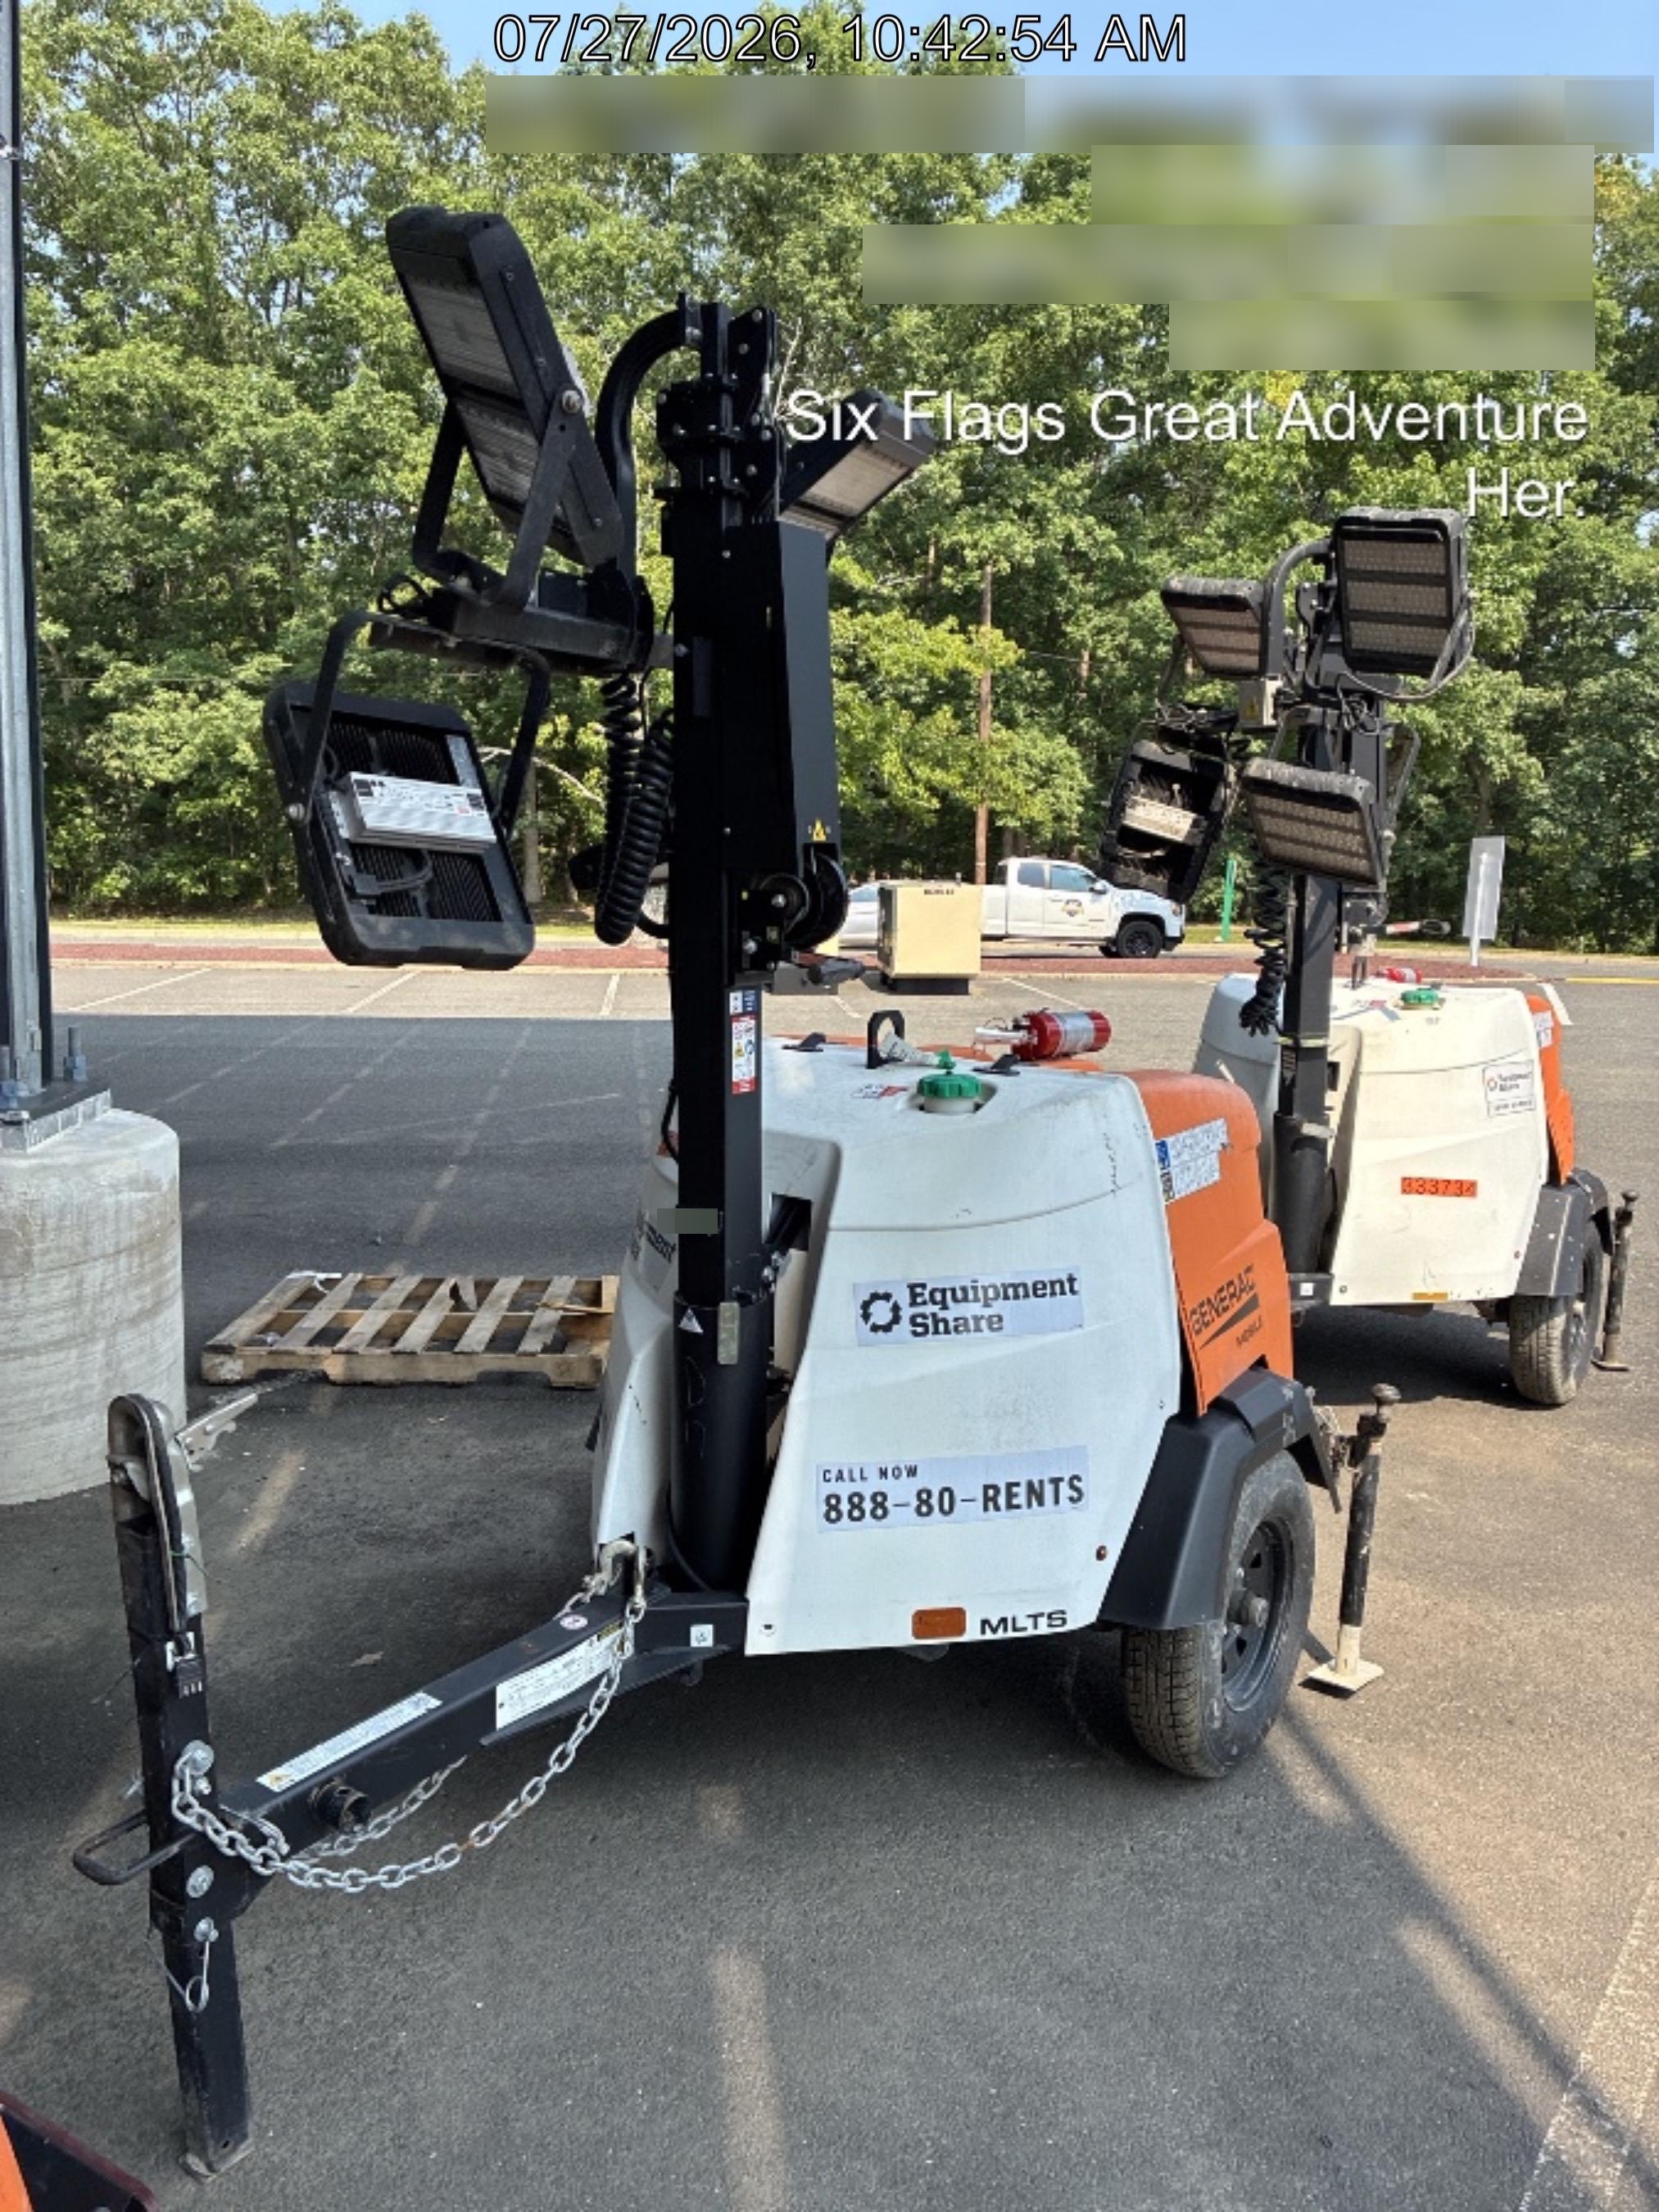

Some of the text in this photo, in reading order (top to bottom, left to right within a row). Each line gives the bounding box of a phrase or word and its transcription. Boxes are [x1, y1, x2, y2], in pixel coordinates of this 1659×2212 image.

[906, 1272, 1080, 1311] Equipment
[1190, 1262, 1257, 1335] GENERAC
[909, 1312, 1004, 1338] Share
[822, 1464, 918, 1483] CALL NOW
[823, 1474, 1085, 1525] 888-80-RENTS
[980, 1609, 1068, 1636] MLTS
